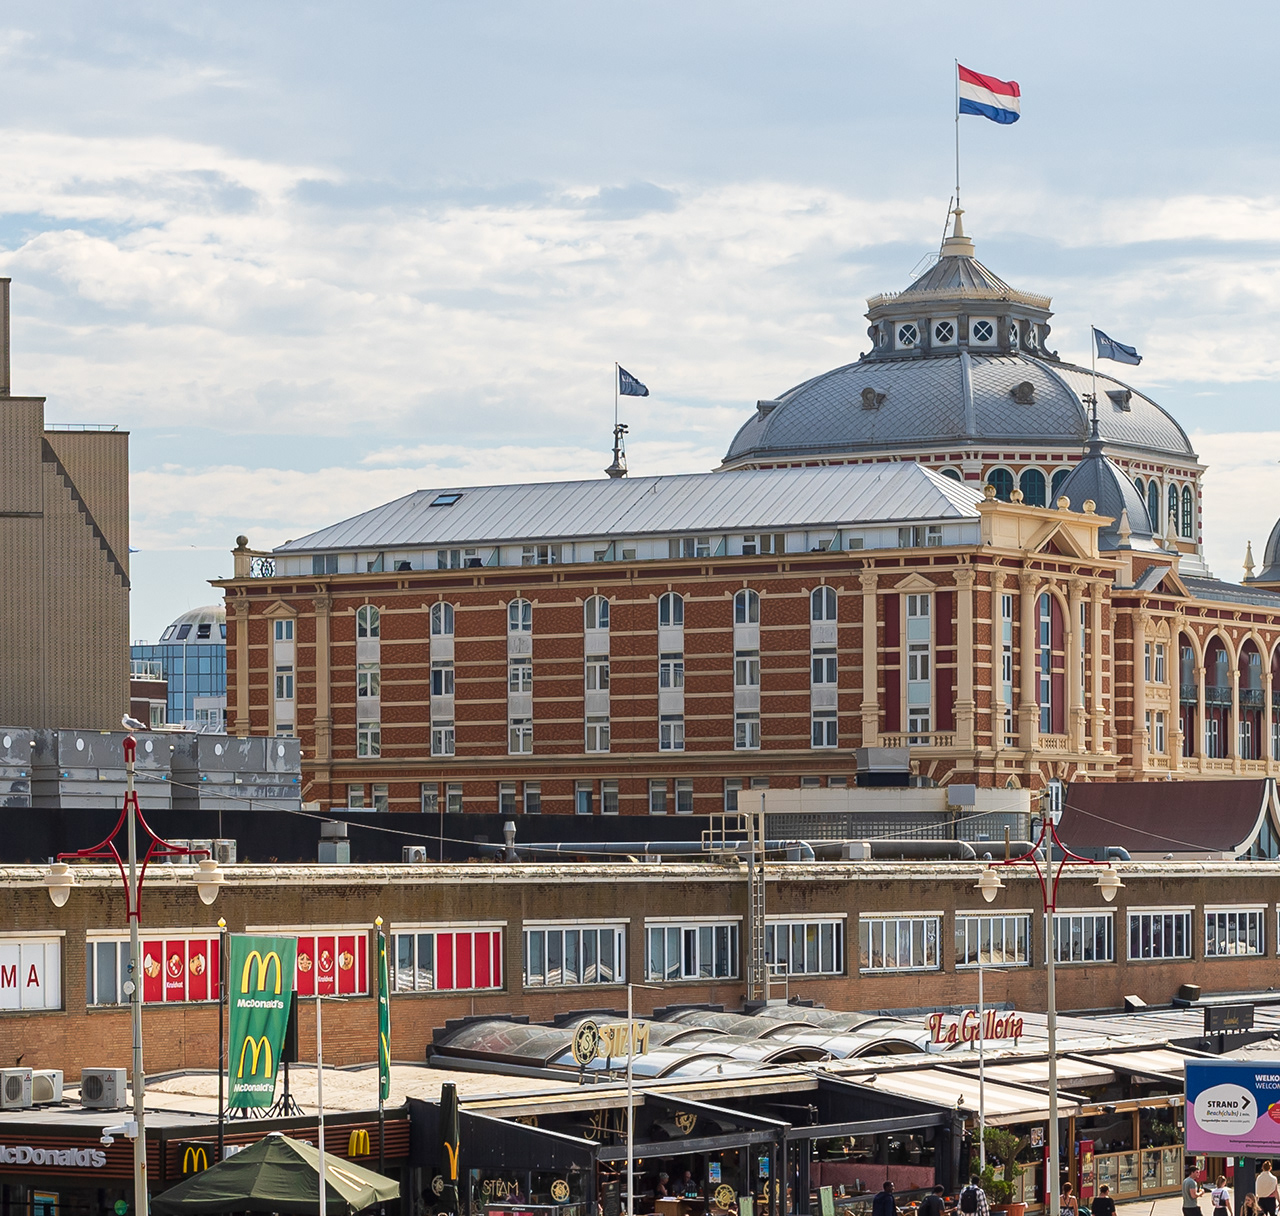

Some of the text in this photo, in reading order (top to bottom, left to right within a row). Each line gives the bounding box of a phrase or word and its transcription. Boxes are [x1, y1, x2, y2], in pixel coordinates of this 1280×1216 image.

[236, 998, 284, 1009] McDonald's
[928, 1009, 1024, 1044] La Galleria
[233, 1083, 275, 1093] McDonald's
[1207, 1100, 1239, 1109] STRAND
[481, 1178, 519, 1197] STEAM
